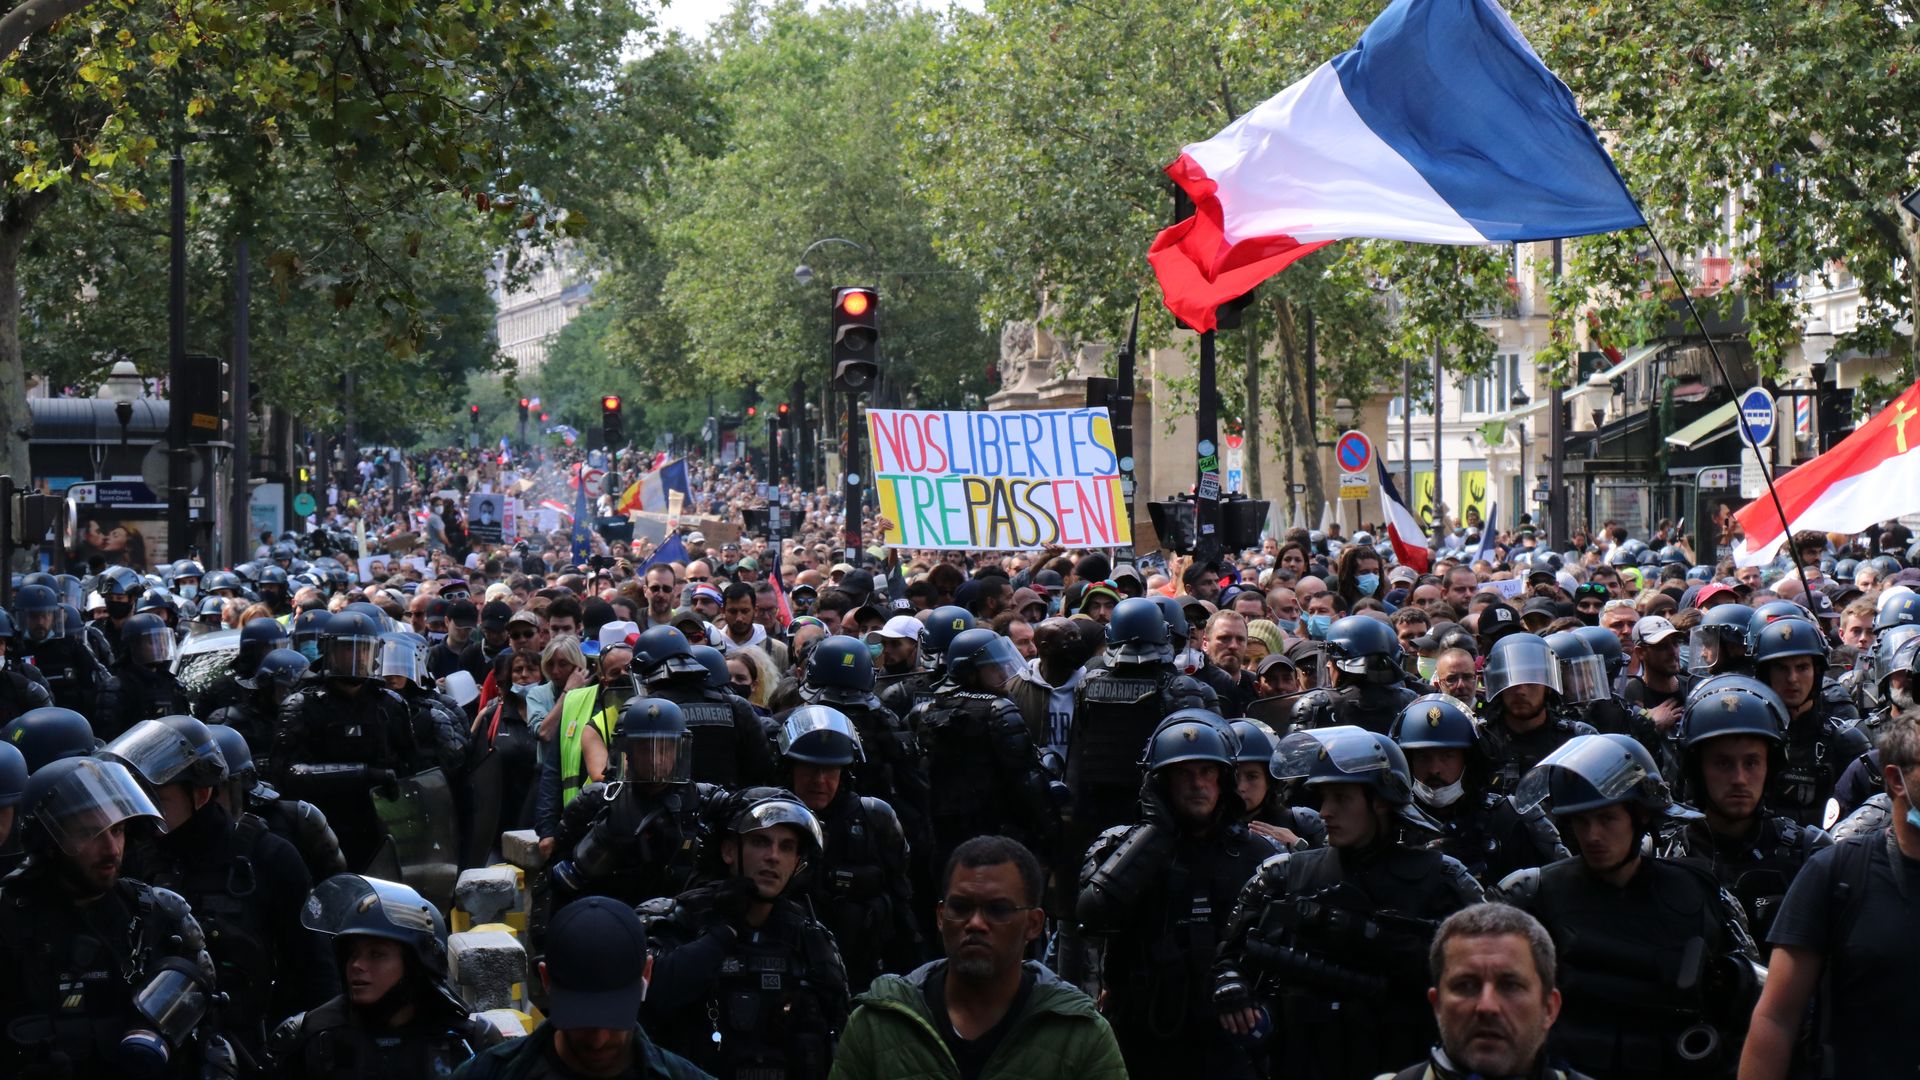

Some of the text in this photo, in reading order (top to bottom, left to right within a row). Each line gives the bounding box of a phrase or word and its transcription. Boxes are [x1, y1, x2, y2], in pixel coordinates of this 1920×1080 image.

[872, 408, 1117, 477] NOS LIBERTÉS
[99, 488, 131, 496] Strasbourg
[681, 705, 733, 721] DARMERIE
